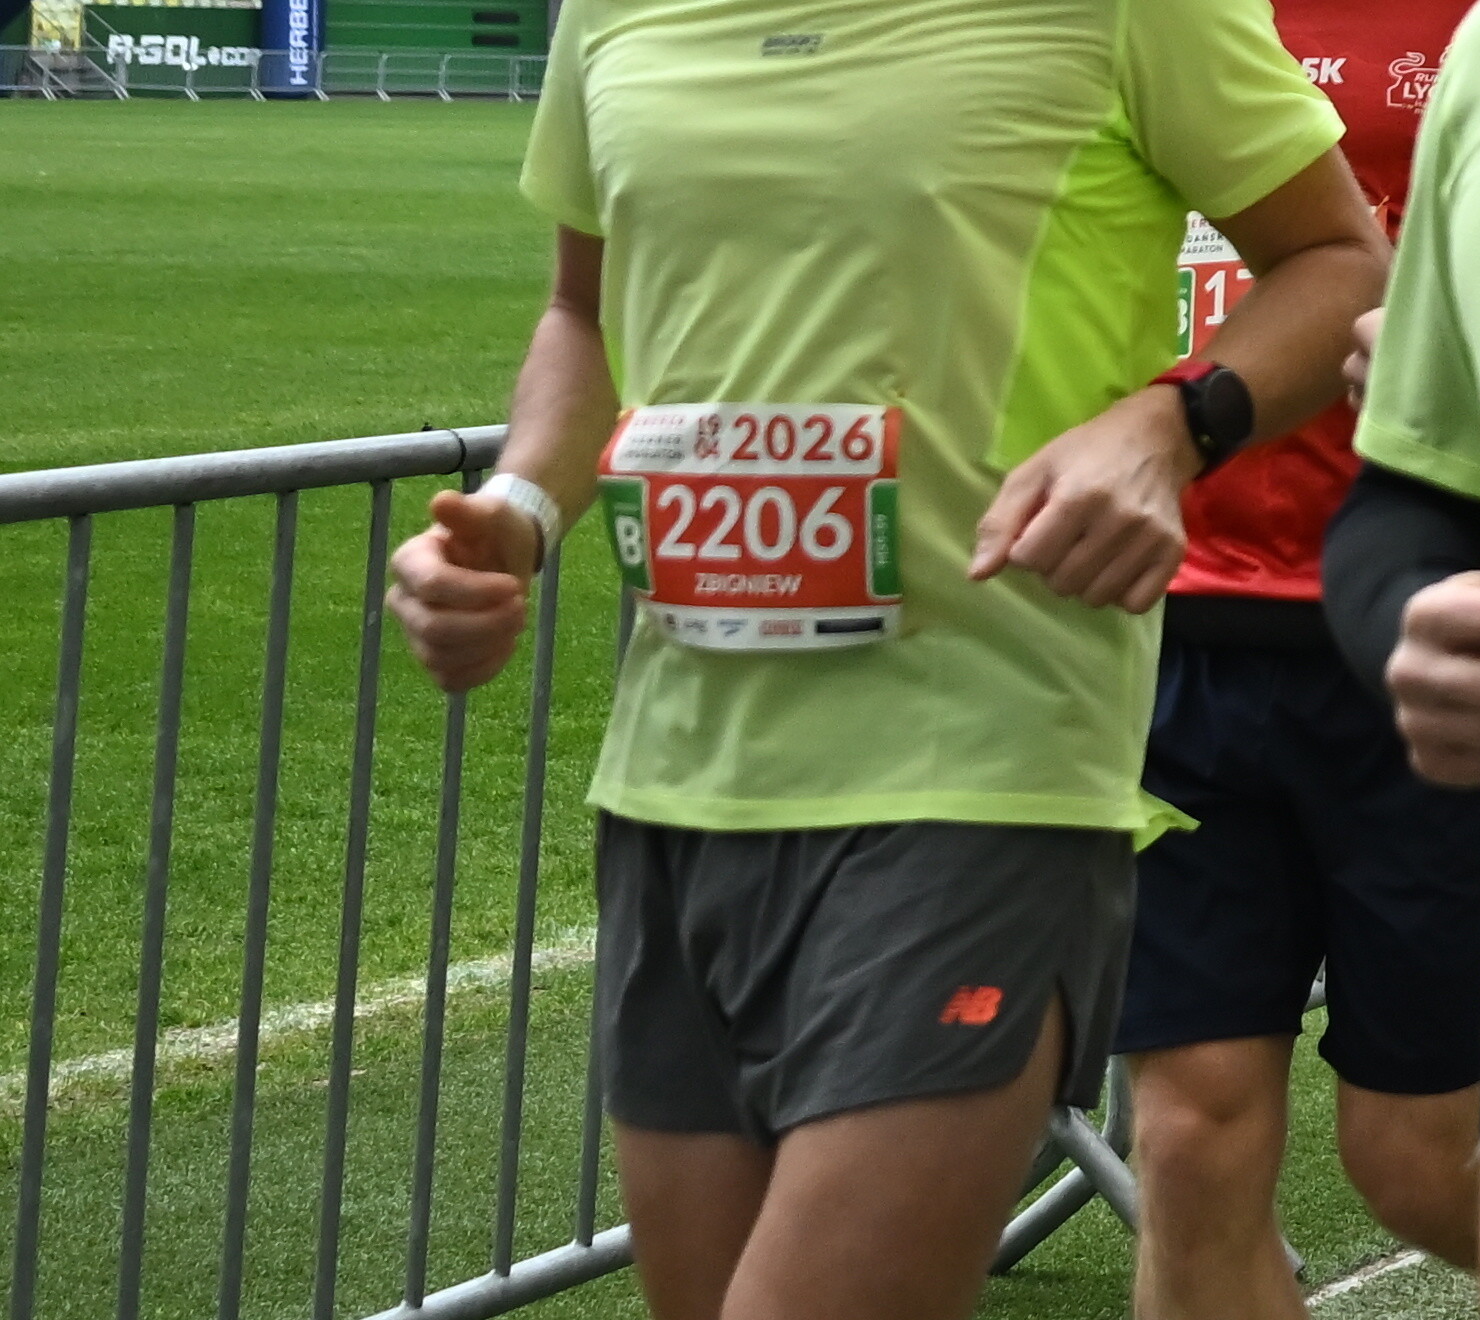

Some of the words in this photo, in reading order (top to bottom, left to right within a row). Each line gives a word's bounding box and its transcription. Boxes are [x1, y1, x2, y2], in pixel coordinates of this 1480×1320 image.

[731, 413, 874, 462] 2026
[614, 515, 644, 566] B
[655, 483, 855, 563] 2206
